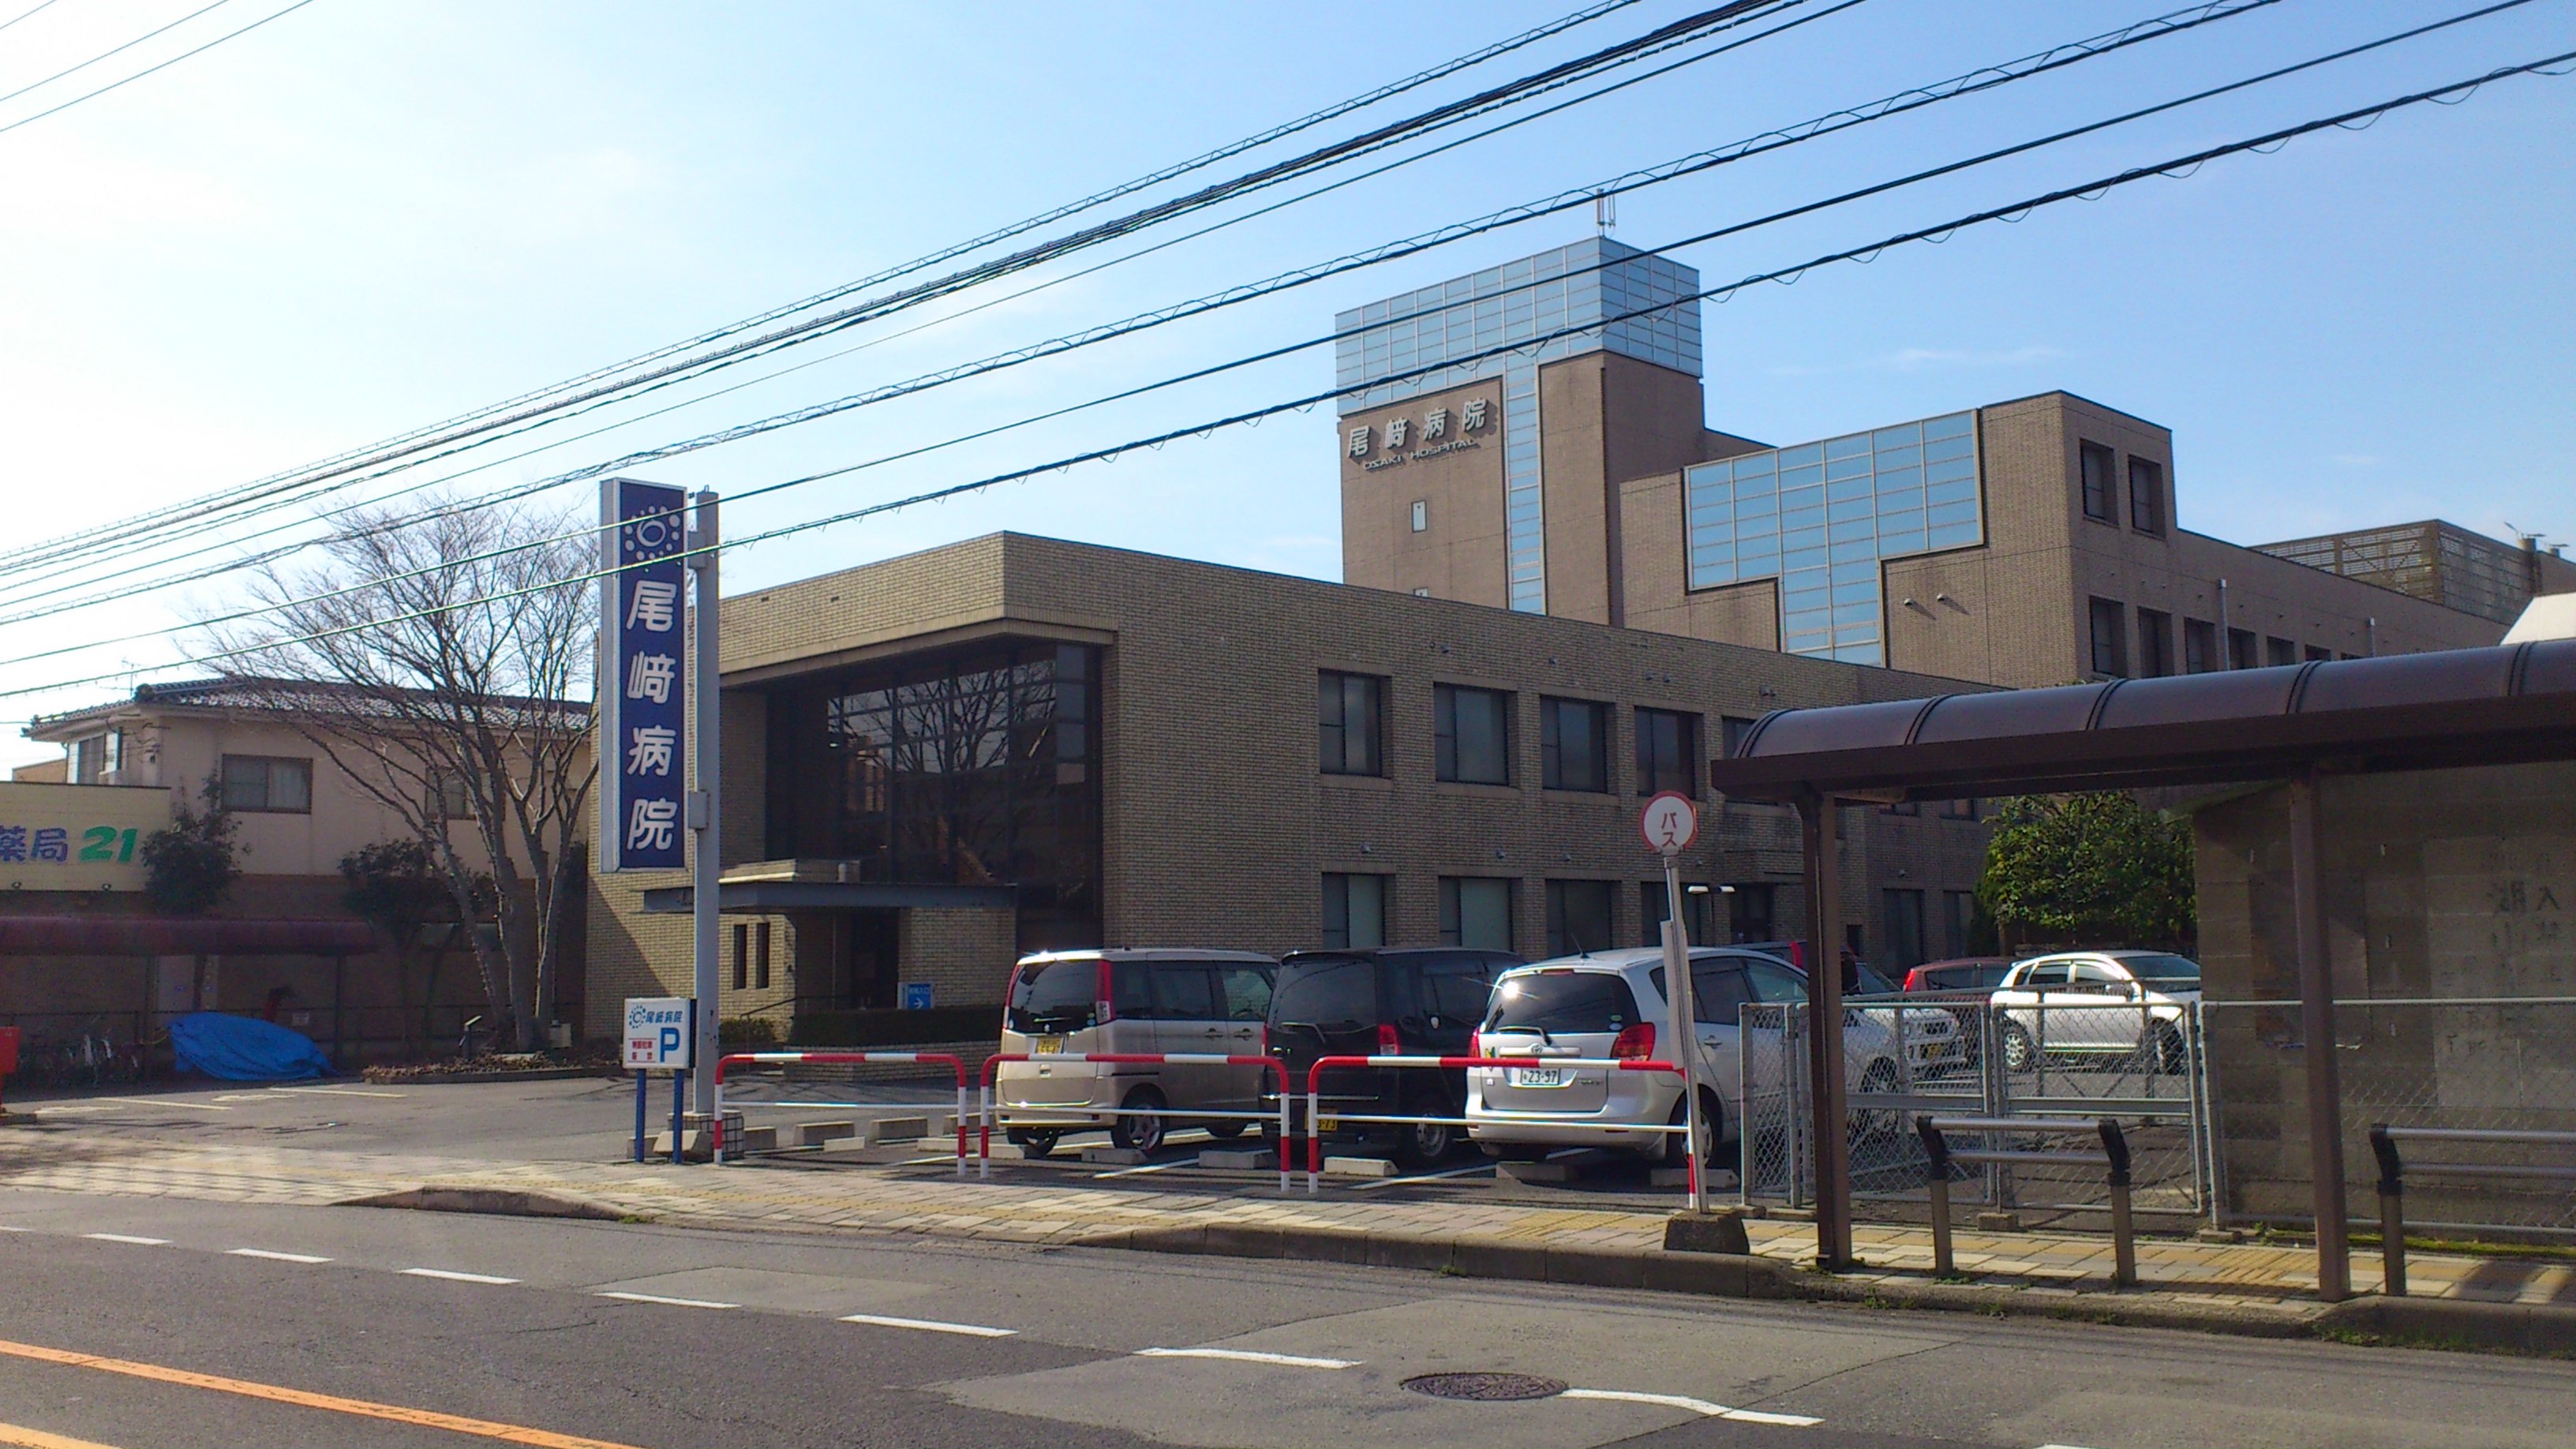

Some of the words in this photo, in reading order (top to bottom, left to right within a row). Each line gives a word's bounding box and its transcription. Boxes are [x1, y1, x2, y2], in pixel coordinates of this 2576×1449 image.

[1363, 455, 1402, 470] OSAKI
[1410, 436, 1479, 460] HOSPITAL
[1661, 811, 1678, 848] バス
[660, 1028, 680, 1063] P
